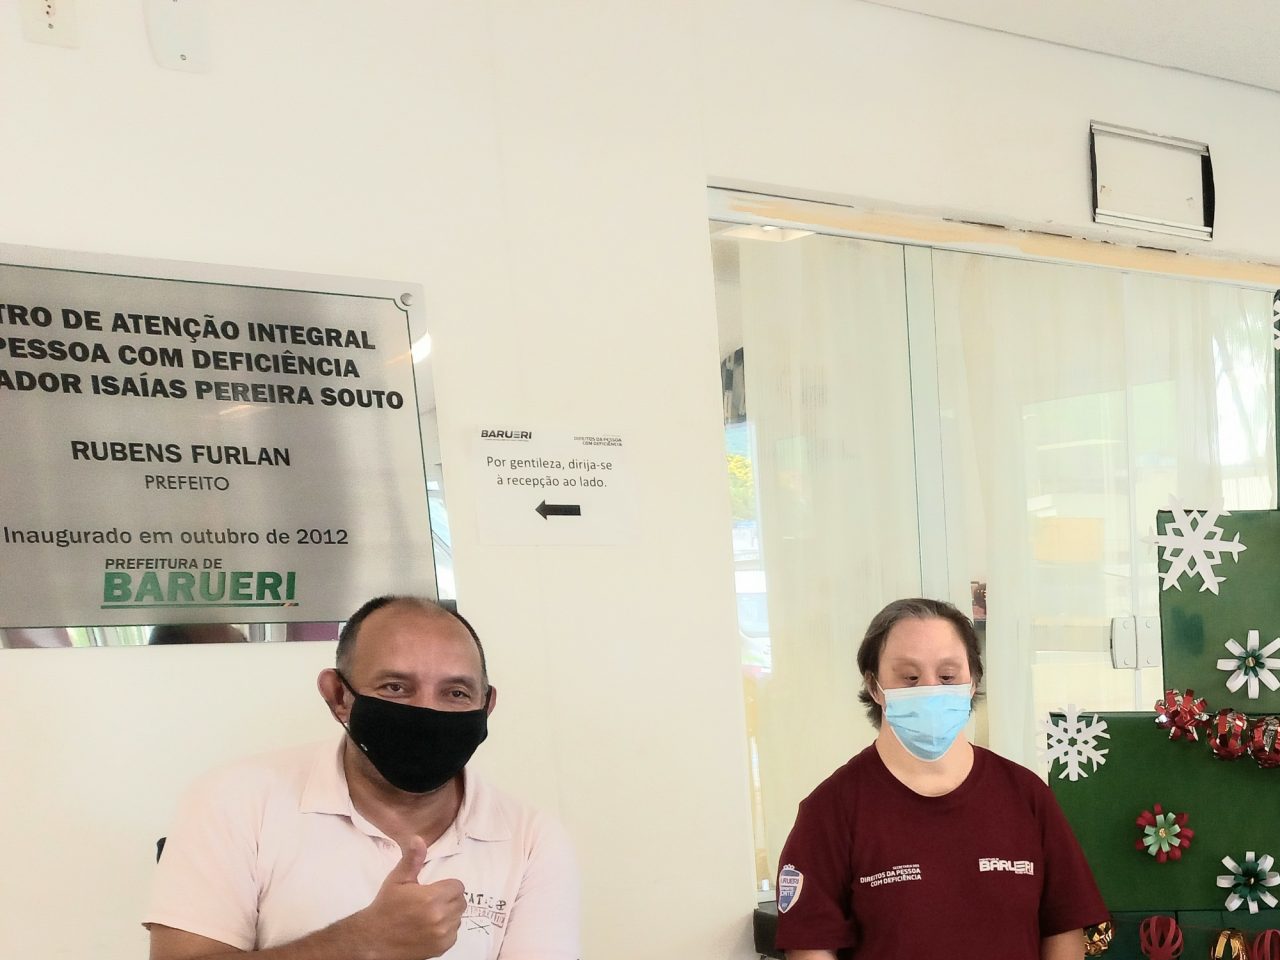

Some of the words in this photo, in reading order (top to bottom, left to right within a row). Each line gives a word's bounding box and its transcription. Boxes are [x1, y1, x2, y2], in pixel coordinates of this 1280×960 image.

[61, 308, 103, 332] DE
[111, 312, 240, 344] ATENÇÃO
[247, 321, 376, 350] INTEGRAL
[118, 344, 184, 368] COM
[191, 349, 361, 378] DEFICIÊNCIA
[0, 369, 83, 394] ADOR
[90, 371, 188, 399] ISAÍAS
[194, 380, 315, 406] PEREIRA
[320, 386, 404, 410] SOUTO
[481, 429, 532, 440] BARUERI
[70, 440, 183, 463] RUBENS
[190, 444, 292, 467] FURLAN
[486, 456, 506, 468] Por
[510, 457, 565, 470] gentileza,
[568, 458, 613, 472] dirija-se
[144, 474, 230, 491] PREFEITO
[496, 474, 504, 485] à
[507, 475, 560, 488] recepção
[563, 478, 577, 488] ao
[579, 476, 607, 488] lado.
[3, 526, 132, 548] Inaugurado
[139, 530, 173, 545] em
[180, 528, 260, 545] outubro
[265, 528, 291, 545] de
[296, 528, 350, 545] 2012
[105, 558, 199, 570] PREFEITURA
[202, 558, 223, 570] DE
[103, 571, 297, 603] BARUERI
[860, 871, 886, 884] DIREITOS
[870, 879, 883, 888] COM
